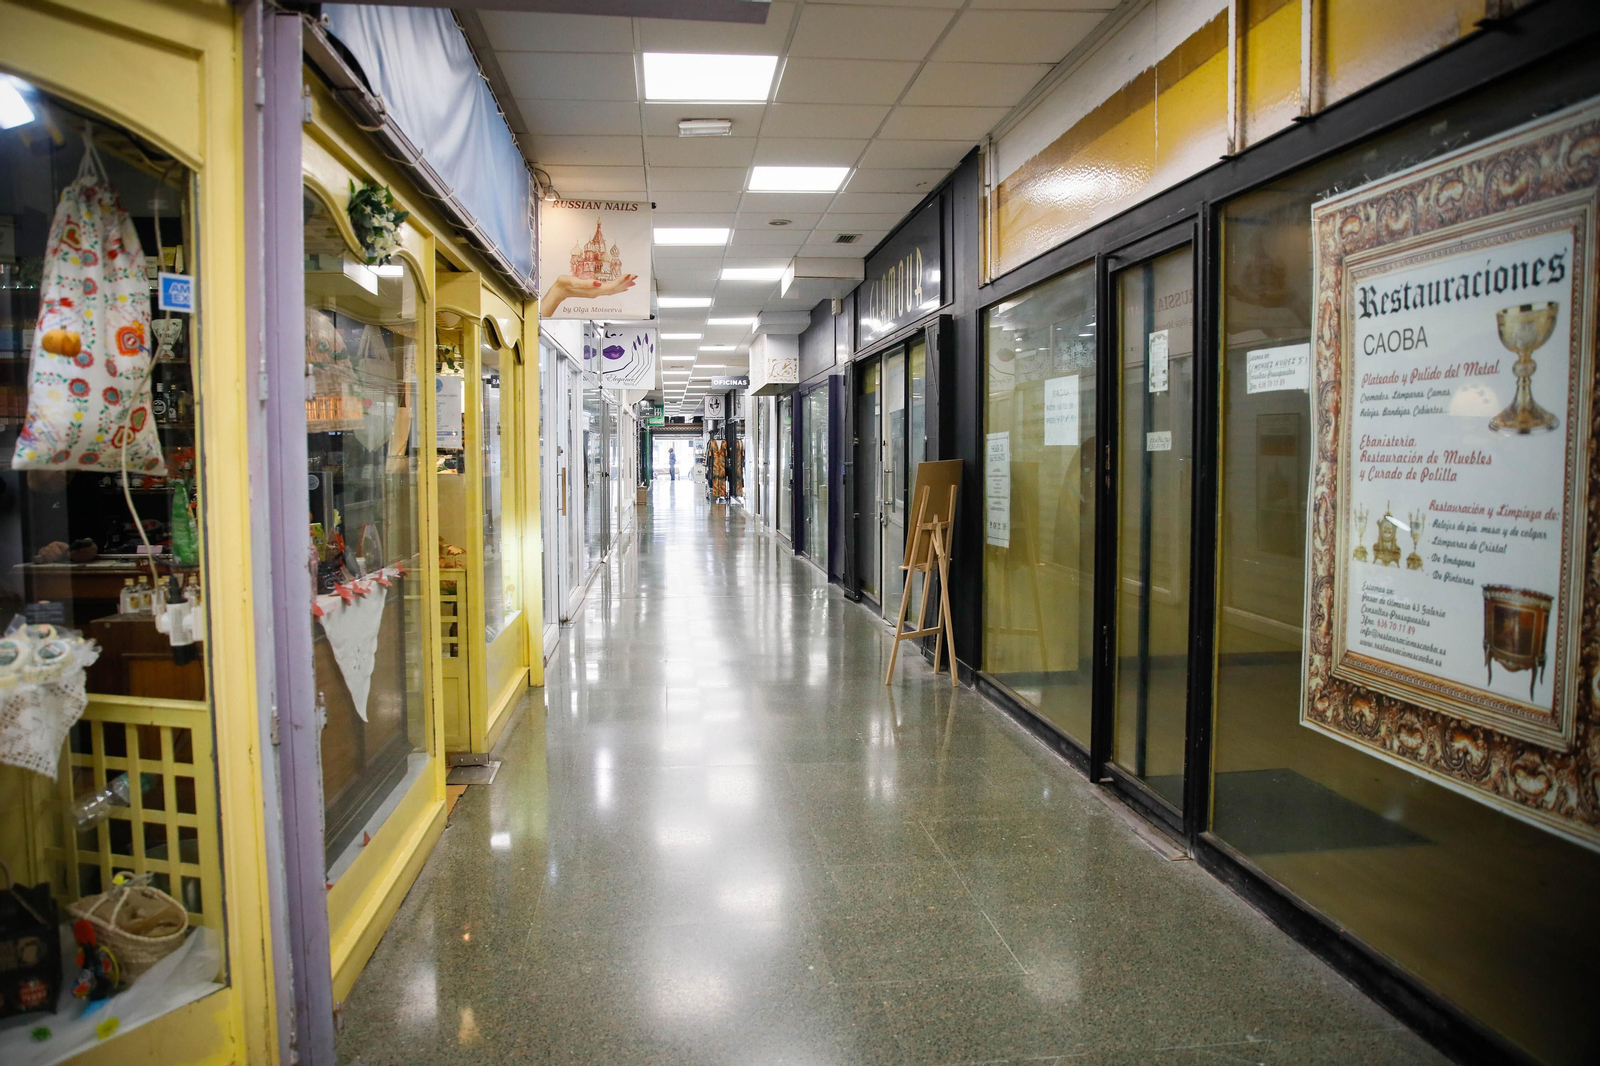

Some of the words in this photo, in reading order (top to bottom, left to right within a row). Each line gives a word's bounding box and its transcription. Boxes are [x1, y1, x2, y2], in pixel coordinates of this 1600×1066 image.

[552, 200, 602, 210] RUSSIAN
[604, 202, 638, 211] NAILS
[1359, 247, 1568, 320] Restauraciones
[562, 306, 572, 314] by
[573, 306, 589, 314] Olga
[1363, 326, 1428, 356] CAOBA
[1361, 370, 1399, 388] Plateado
[1402, 374, 1408, 386] y
[1410, 366, 1442, 384] Pulido
[1444, 363, 1461, 378] del
[1463, 359, 1500, 377] Metal
[1360, 450, 1423, 464] Restauración
[1426, 450, 1438, 464] de
[1443, 450, 1492, 466] Muebles
[1359, 469, 1366, 481] y
[1368, 465, 1402, 482] Curado
[1405, 467, 1418, 480] de
[1420, 466, 1458, 483] Polilla
[1429, 500, 1485, 515] Restauración
[1487, 507, 1494, 519] y
[1496, 504, 1542, 522] Limpieza
[1457, 520, 1466, 532] de
[1480, 526, 1501, 534] mesa
[1502, 528, 1508, 538] y
[1510, 526, 1518, 536] de
[1520, 528, 1548, 541] colgar
[1469, 540, 1478, 550] de
[1478, 541, 1508, 554] Cristal
[1431, 553, 1440, 562] De
[1432, 570, 1442, 580] De
[1444, 571, 1474, 586] Pinturas
[1376, 618, 1388, 628] 636
[1389, 620, 1397, 631] 70
[1399, 624, 1406, 633] 11
[1407, 626, 1416, 635] 89
